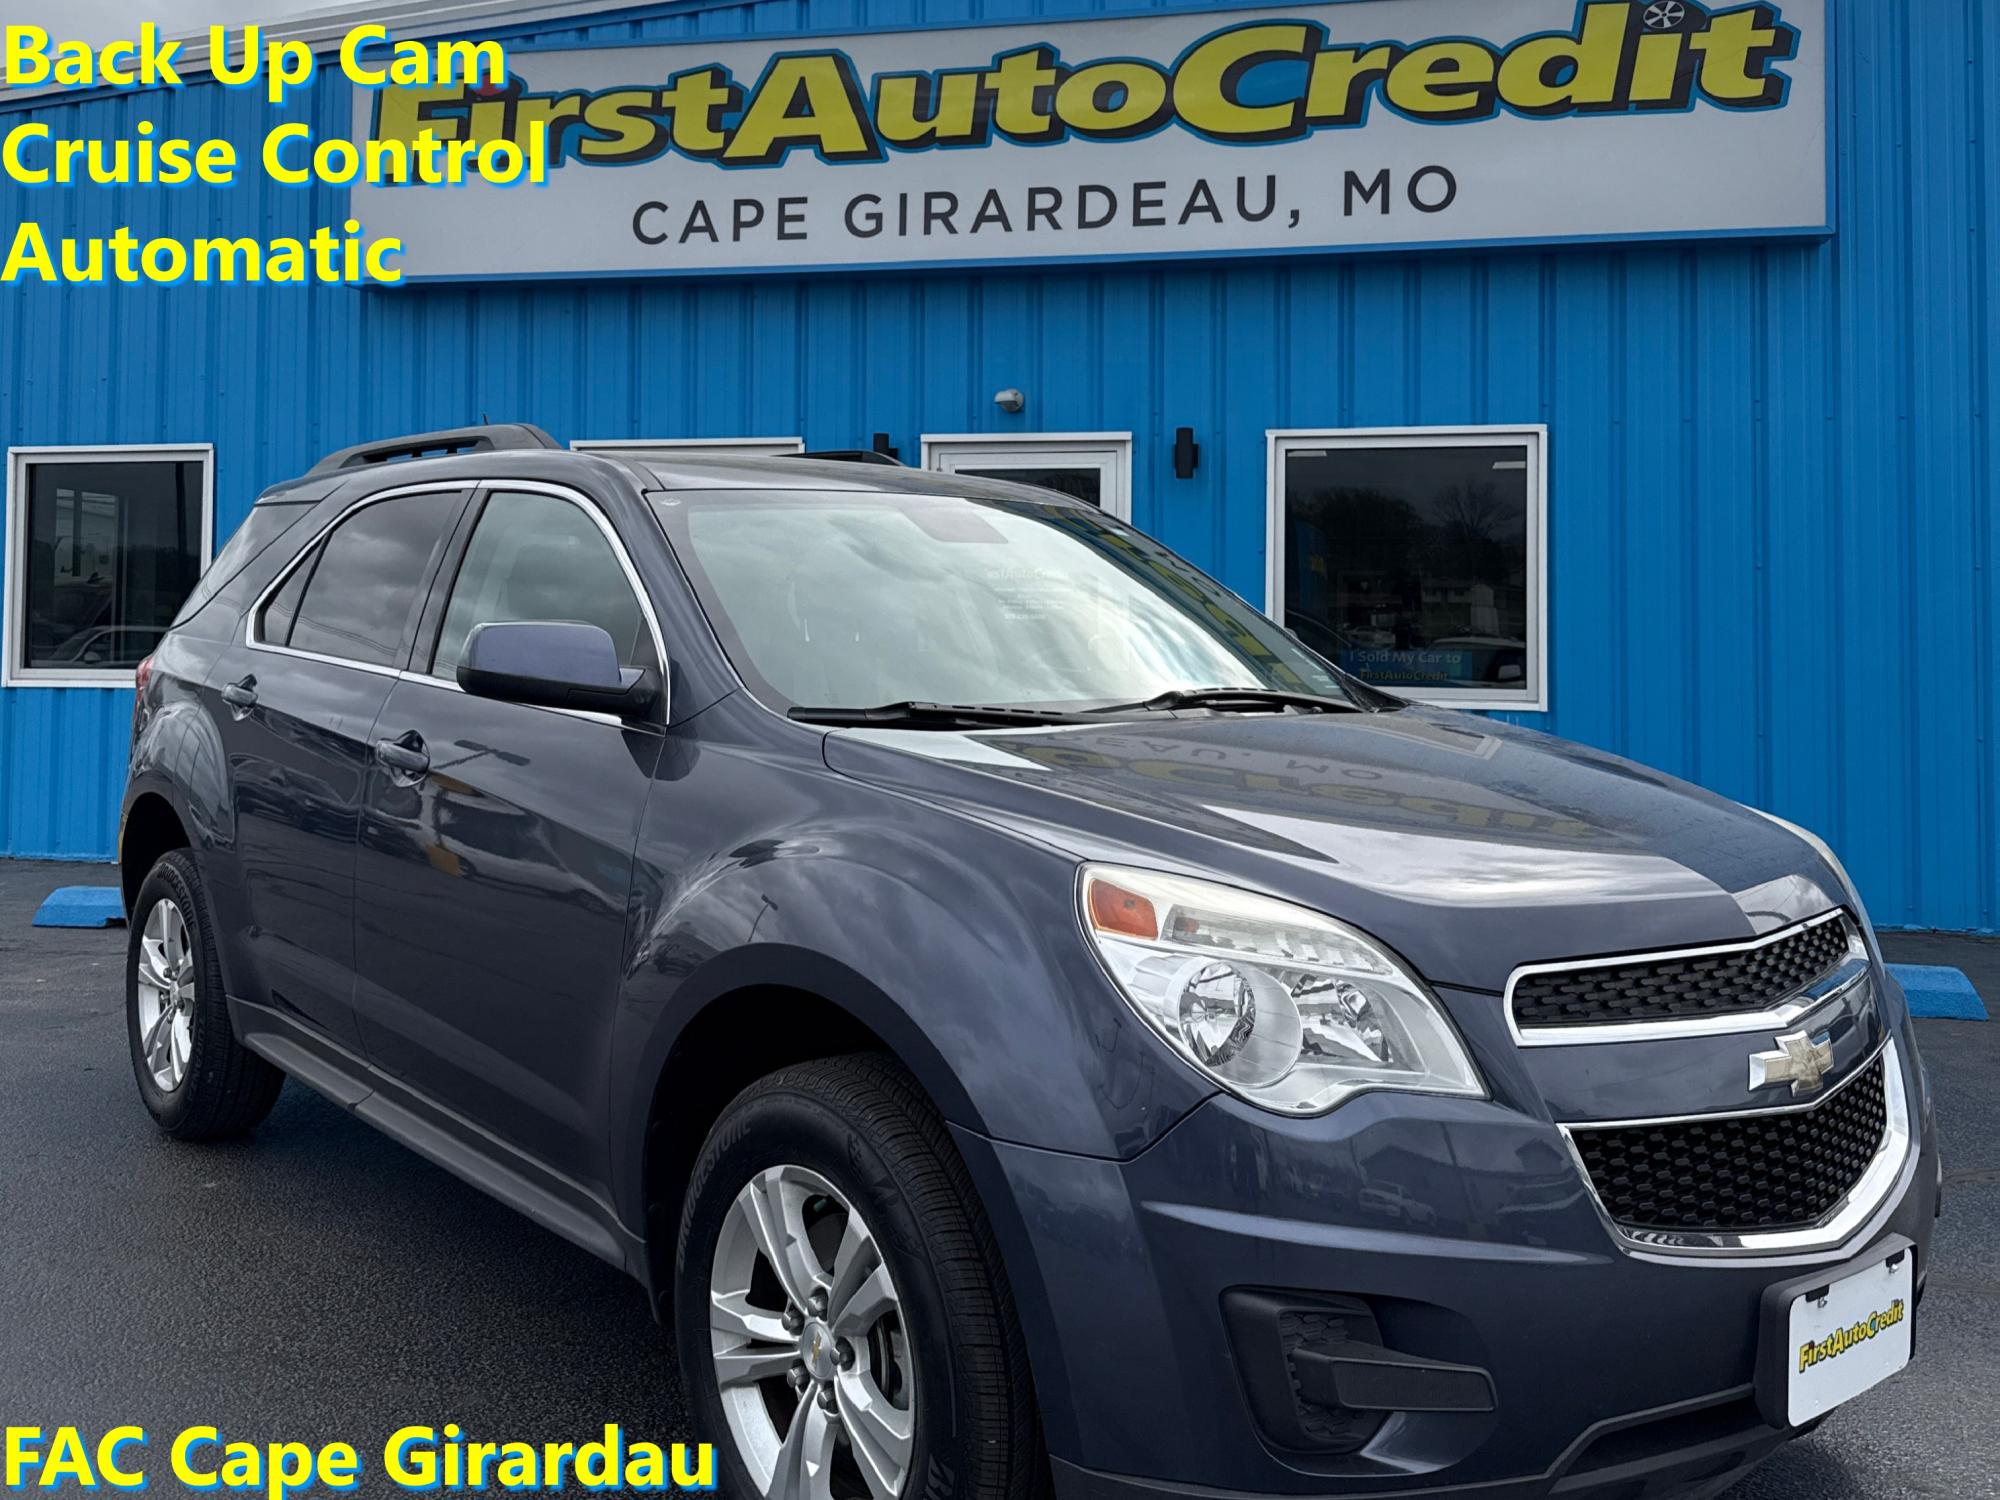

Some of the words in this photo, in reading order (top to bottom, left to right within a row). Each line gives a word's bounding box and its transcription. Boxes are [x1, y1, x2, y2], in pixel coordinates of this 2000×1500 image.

[370, 0, 1800, 187] FirstAutoCredit
[632, 196, 809, 245] CAPE
[844, 174, 1301, 239] GIRARDEAU,
[1343, 165, 1458, 217] MO
[1357, 649, 1389, 663] Sold
[1392, 651, 1416, 666] My
[1418, 650, 1444, 663] Car
[1447, 651, 1462, 663] to
[1798, 1298, 1905, 1373] FirstAutoCredit
